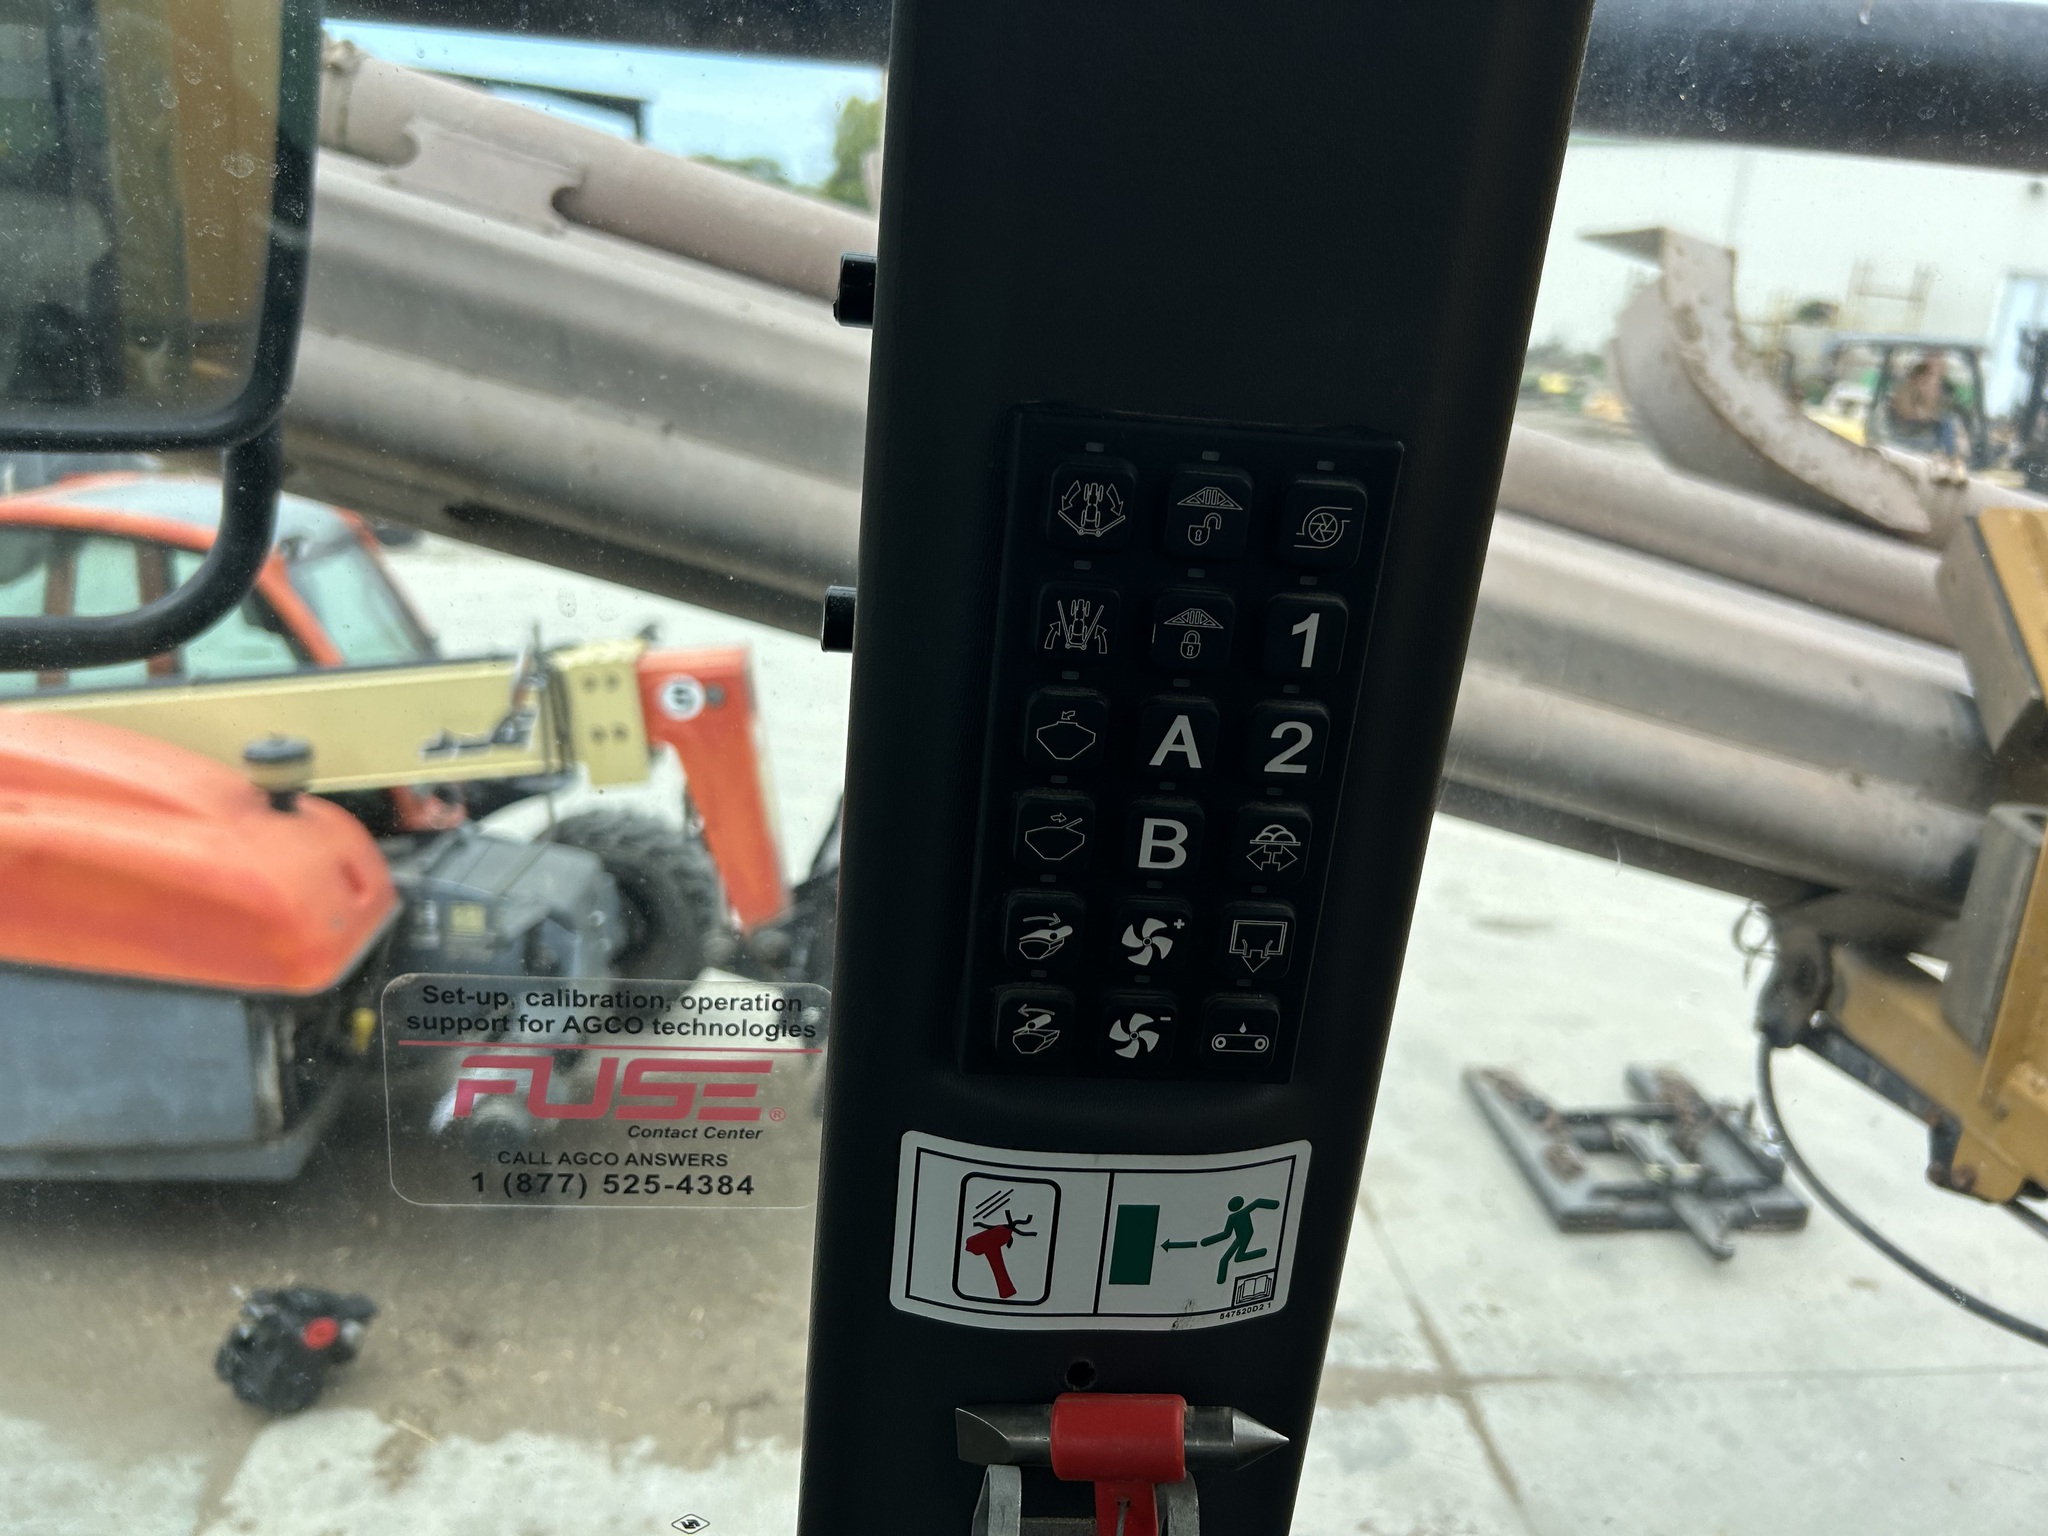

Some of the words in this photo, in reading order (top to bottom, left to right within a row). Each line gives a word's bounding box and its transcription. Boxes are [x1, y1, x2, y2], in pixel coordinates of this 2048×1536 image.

[1291, 612, 1320, 668] 1
[1148, 714, 1202, 769] A
[1264, 721, 1313, 774] 2
[1138, 817, 1188, 870] B
[422, 984, 516, 1010] Set-up,
[526, 988, 672, 1012] calibration,
[681, 993, 802, 1014] operation
[406, 1015, 510, 1035] support
[518, 1014, 556, 1033] for
[562, 1015, 644, 1034] AGCO
[652, 1018, 817, 1042] technologies
[627, 1124, 698, 1140] Contact
[703, 1126, 763, 1140] Center
[497, 1150, 552, 1165] CALL
[558, 1151, 619, 1166] AGCO
[625, 1152, 729, 1167] ANSWERS
[471, 1172, 485, 1193] 1
[503, 1172, 588, 1199] (877)
[603, 1173, 755, 1195] 525-4384
